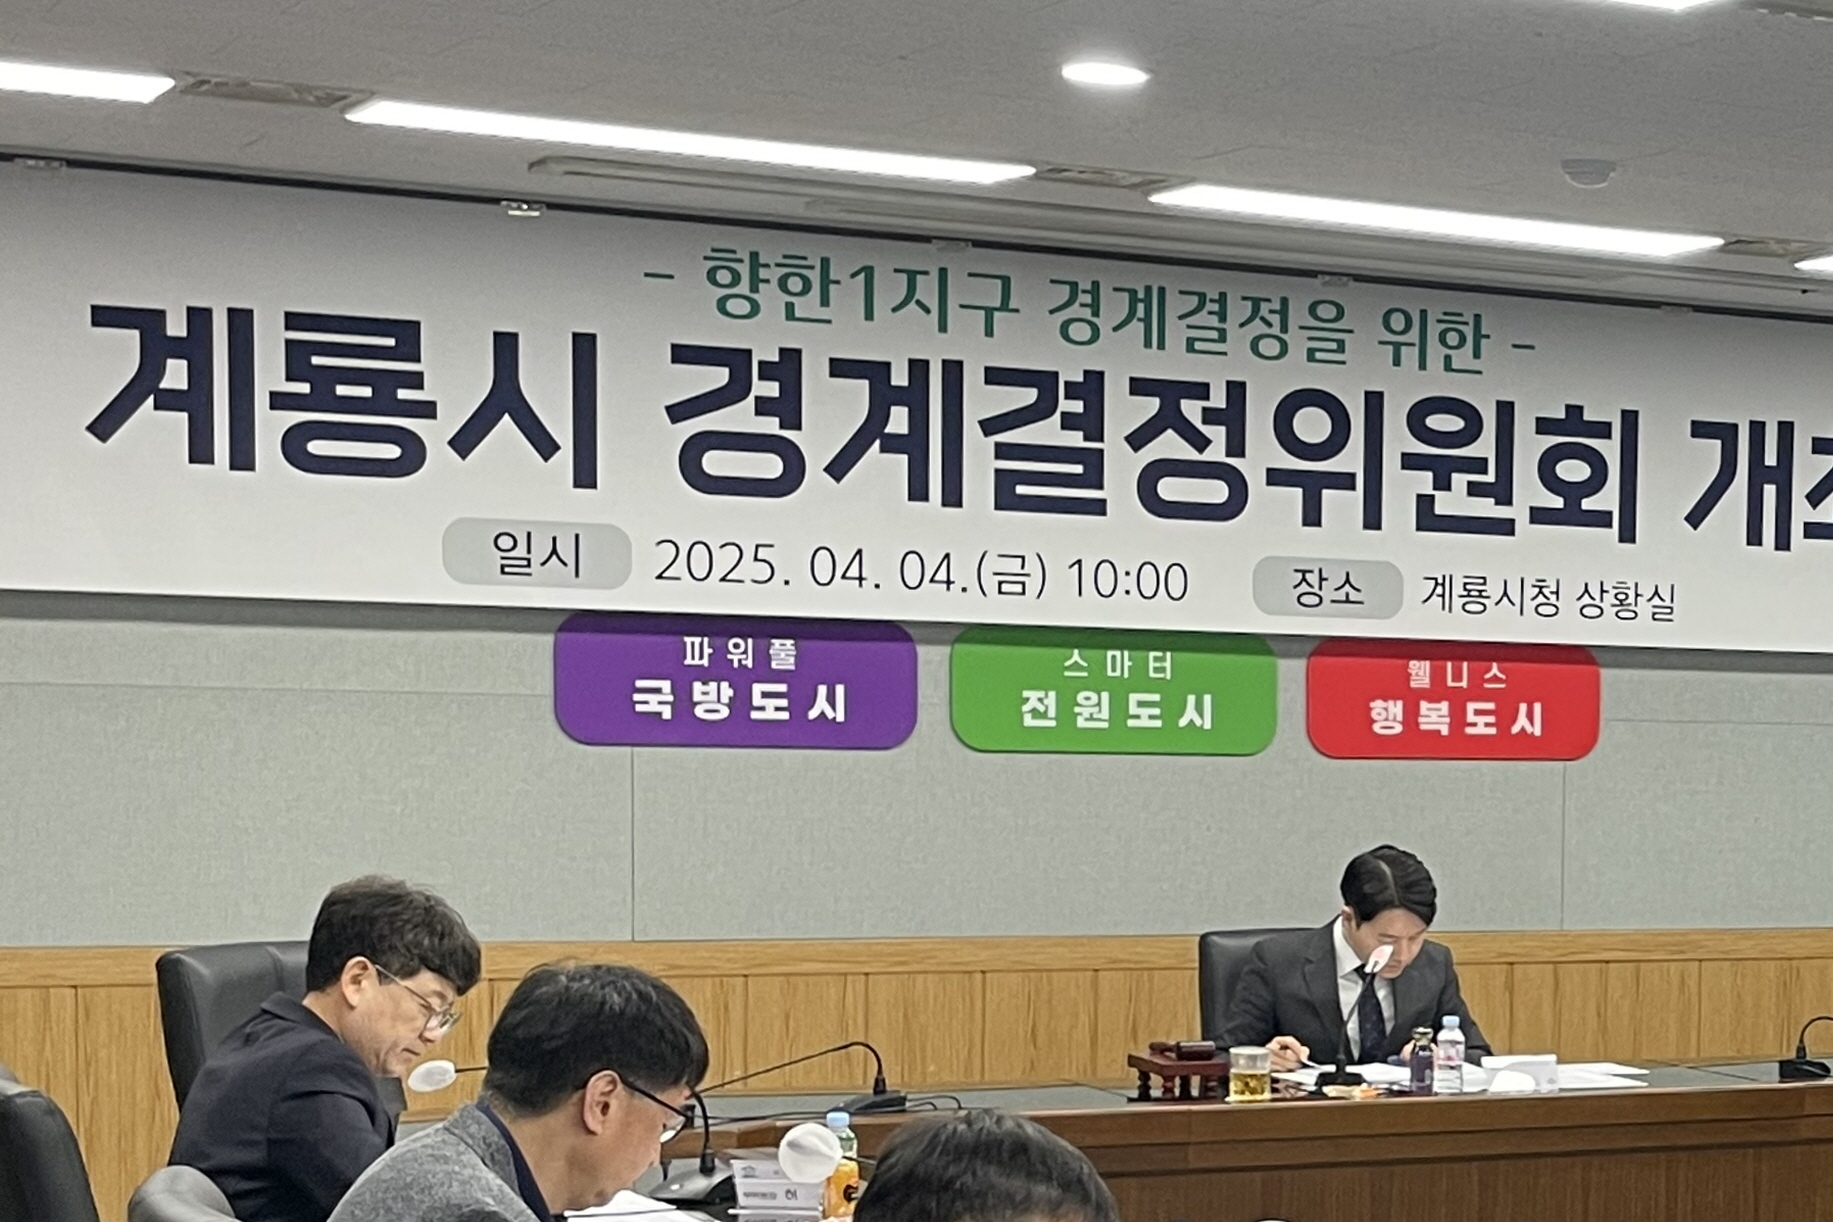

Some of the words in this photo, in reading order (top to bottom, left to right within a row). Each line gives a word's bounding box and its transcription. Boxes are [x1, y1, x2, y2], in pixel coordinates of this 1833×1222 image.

[702, 246, 1020, 338] 향한1지구
[1047, 277, 1355, 366] 경계결정을
[1377, 305, 1491, 376] 위한
[84, 303, 599, 490] 계룡시
[664, 342, 1640, 545] 경계결정위원회
[492, 529, 582, 579] 일시
[654, 538, 791, 586] 2025.
[809, 545, 882, 590] 04.
[899, 549, 1047, 600] 04.(금)
[1067, 558, 1190, 602] 10:00
[1292, 567, 1366, 609] 장소
[1421, 573, 1562, 618] 계룡시청
[1575, 580, 1677, 623] 상황실
[682, 636, 798, 670] 파워풀
[1062, 648, 1174, 681] 스마터
[1407, 660, 1508, 690] 웰니스
[632, 679, 847, 723] 국방도시
[1021, 690, 1213, 730] 전원도시
[1369, 699, 1542, 737] 행복도시
